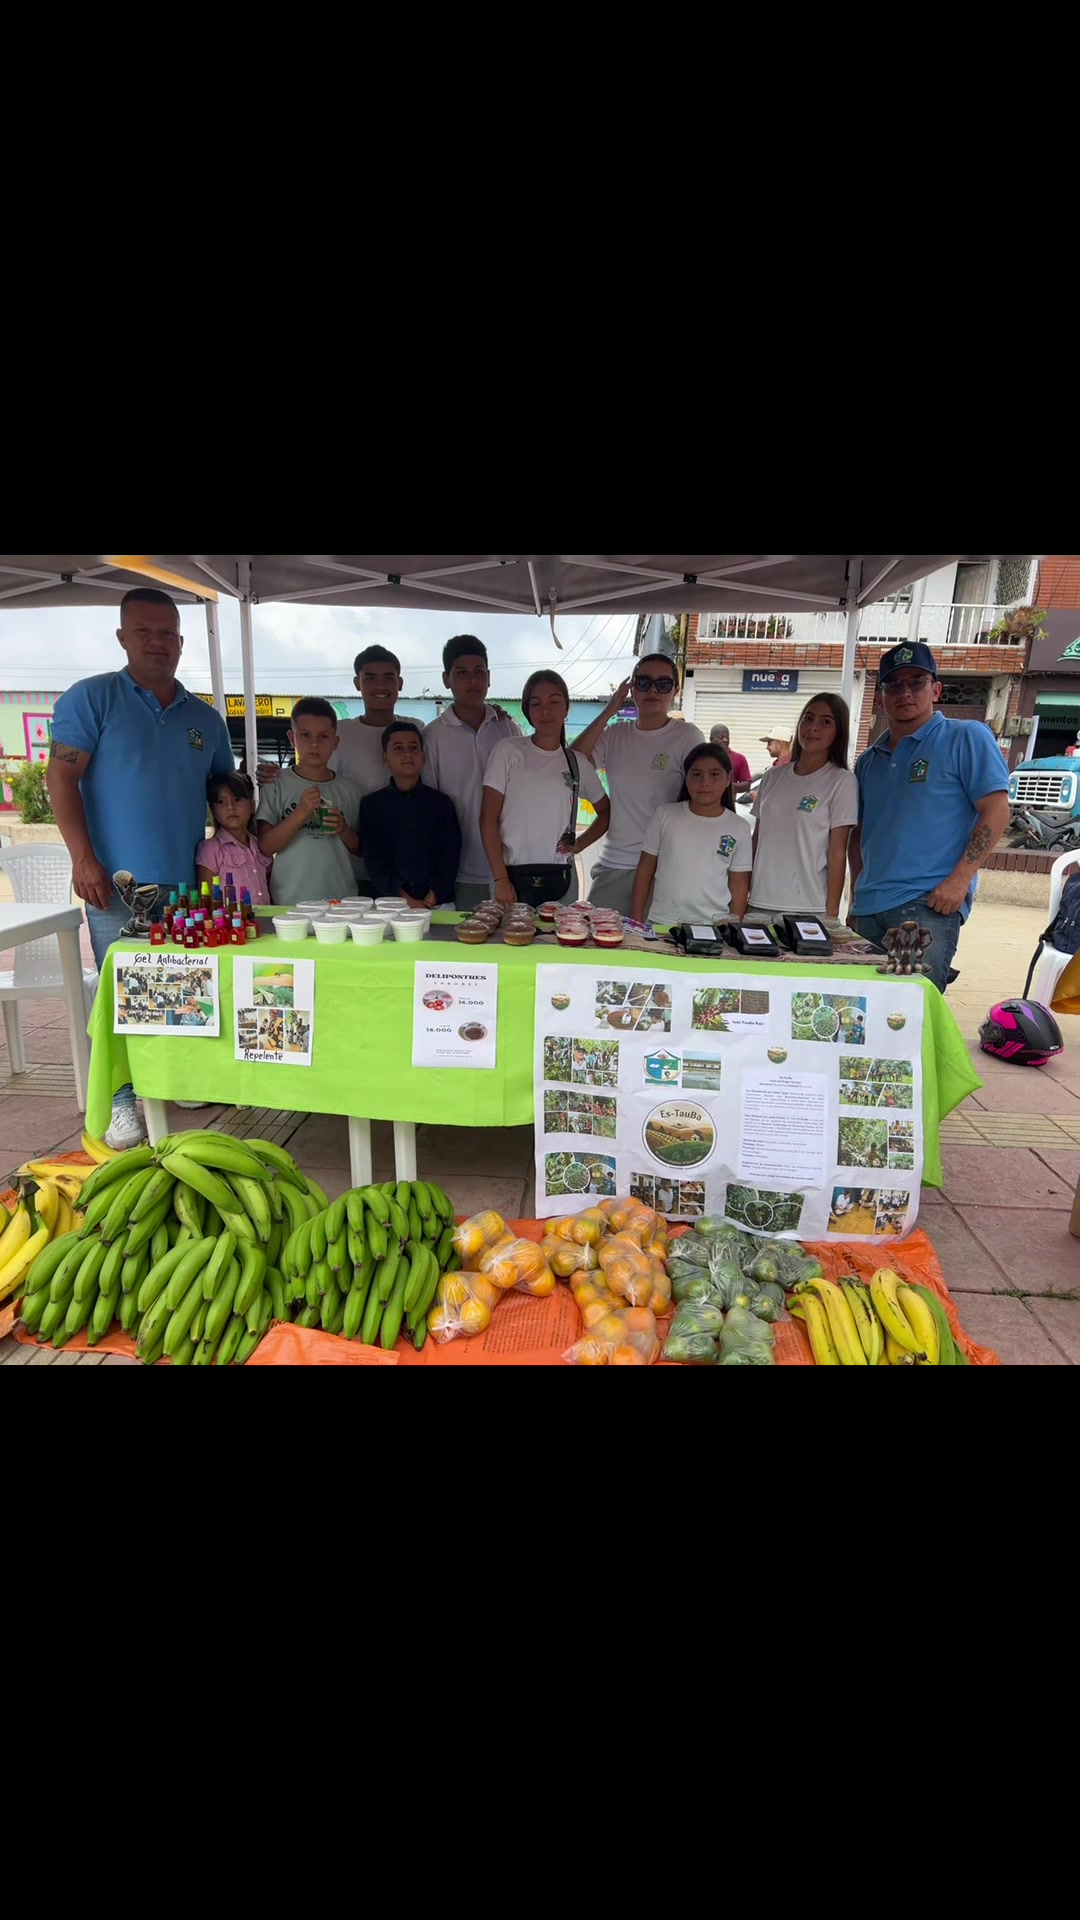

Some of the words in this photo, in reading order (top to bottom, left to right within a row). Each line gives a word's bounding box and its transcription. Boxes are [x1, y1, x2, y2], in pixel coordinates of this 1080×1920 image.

[228, 698, 270, 707] LAVERO
[133, 953, 152, 966] Gel
[157, 954, 208, 966] Antibacterial
[244, 1048, 284, 1062] Repelente
[660, 1109, 702, 1122] Es-TauBa
